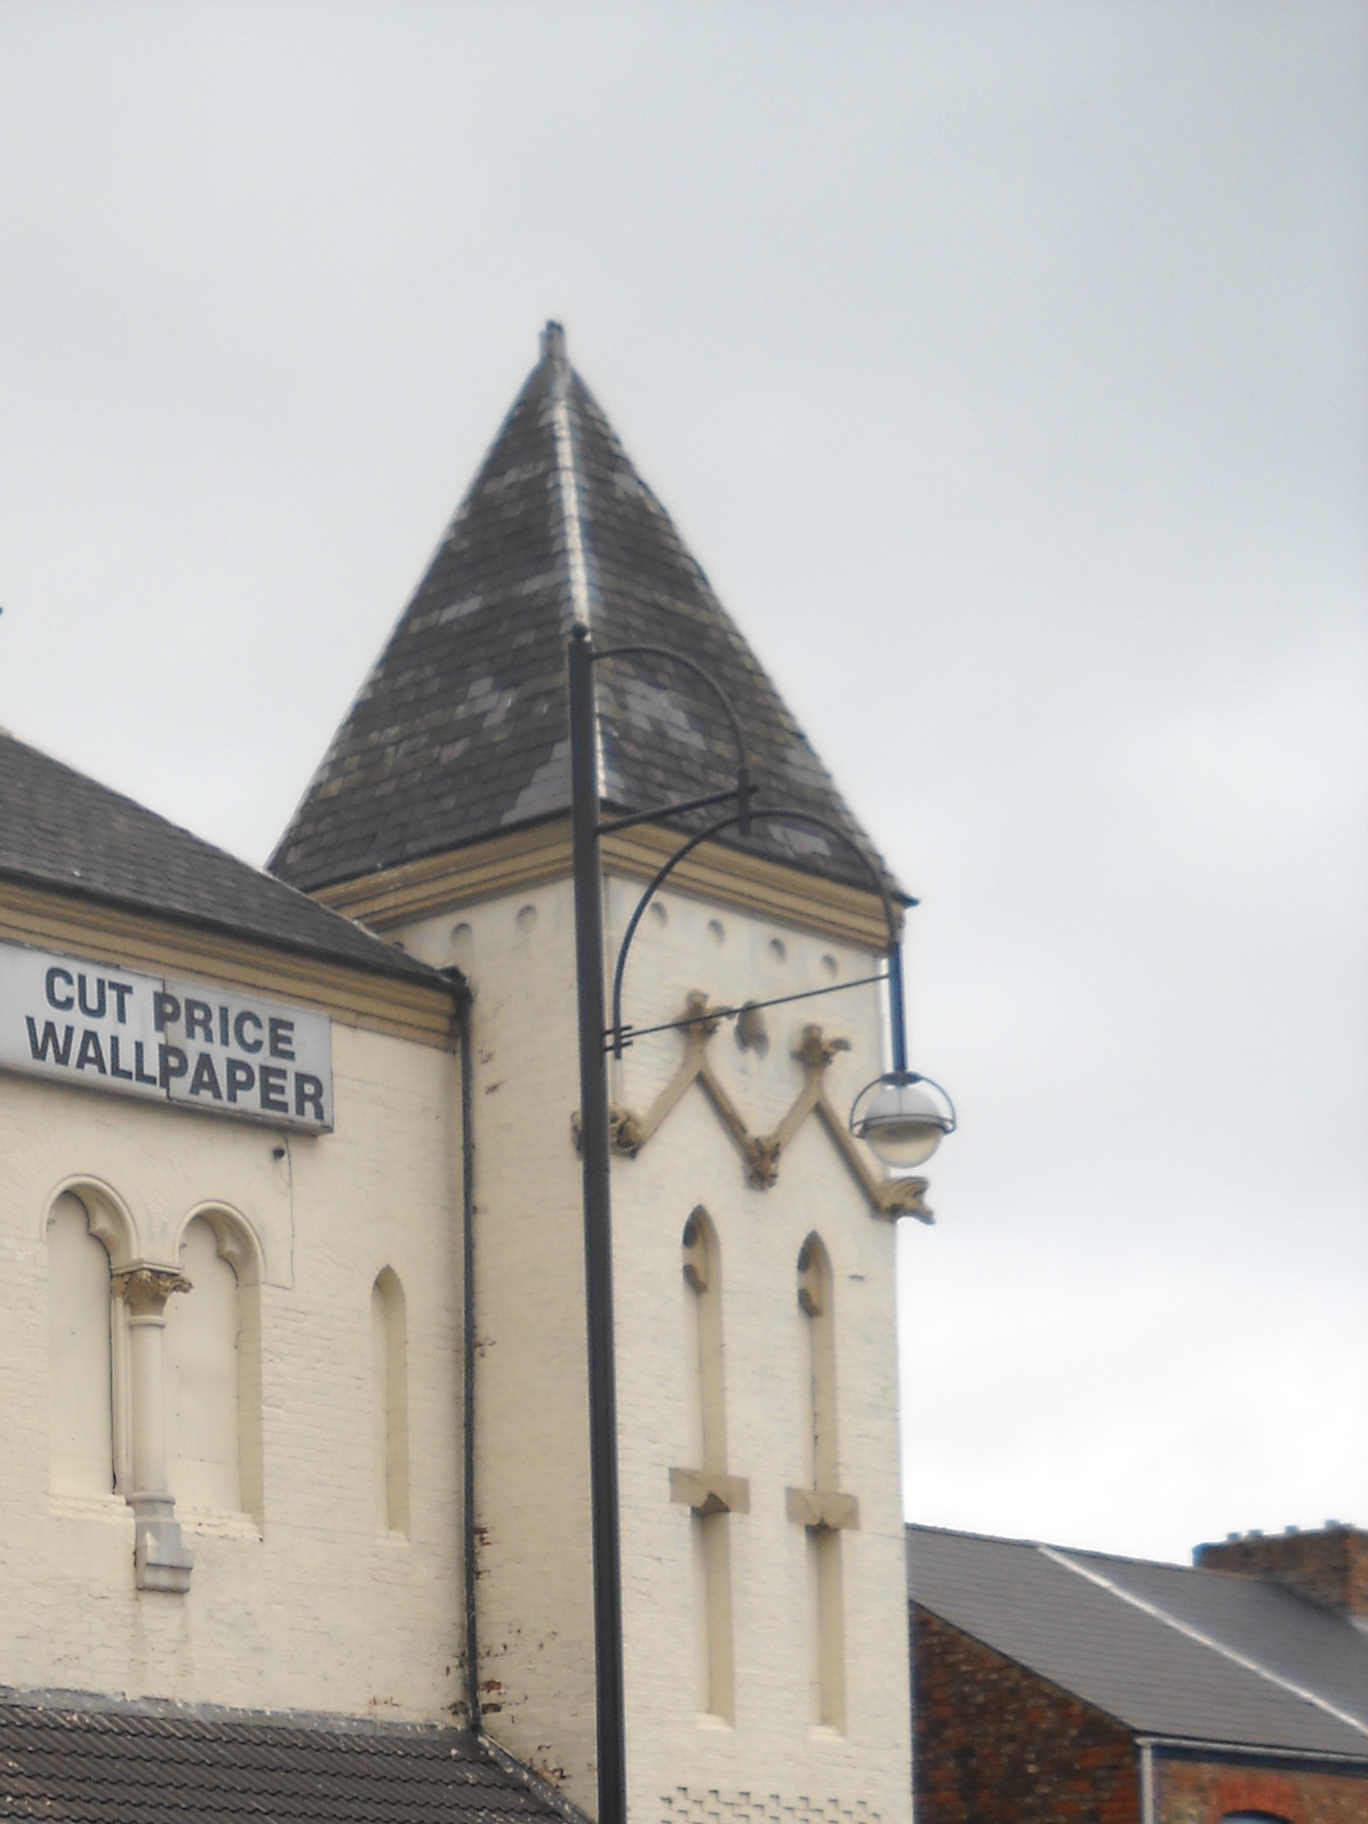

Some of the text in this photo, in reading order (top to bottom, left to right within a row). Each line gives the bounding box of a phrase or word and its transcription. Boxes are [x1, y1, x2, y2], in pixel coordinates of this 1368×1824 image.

[44, 966, 296, 1062] CUT PRICE
[25, 1015, 325, 1121] WALLPAPER
